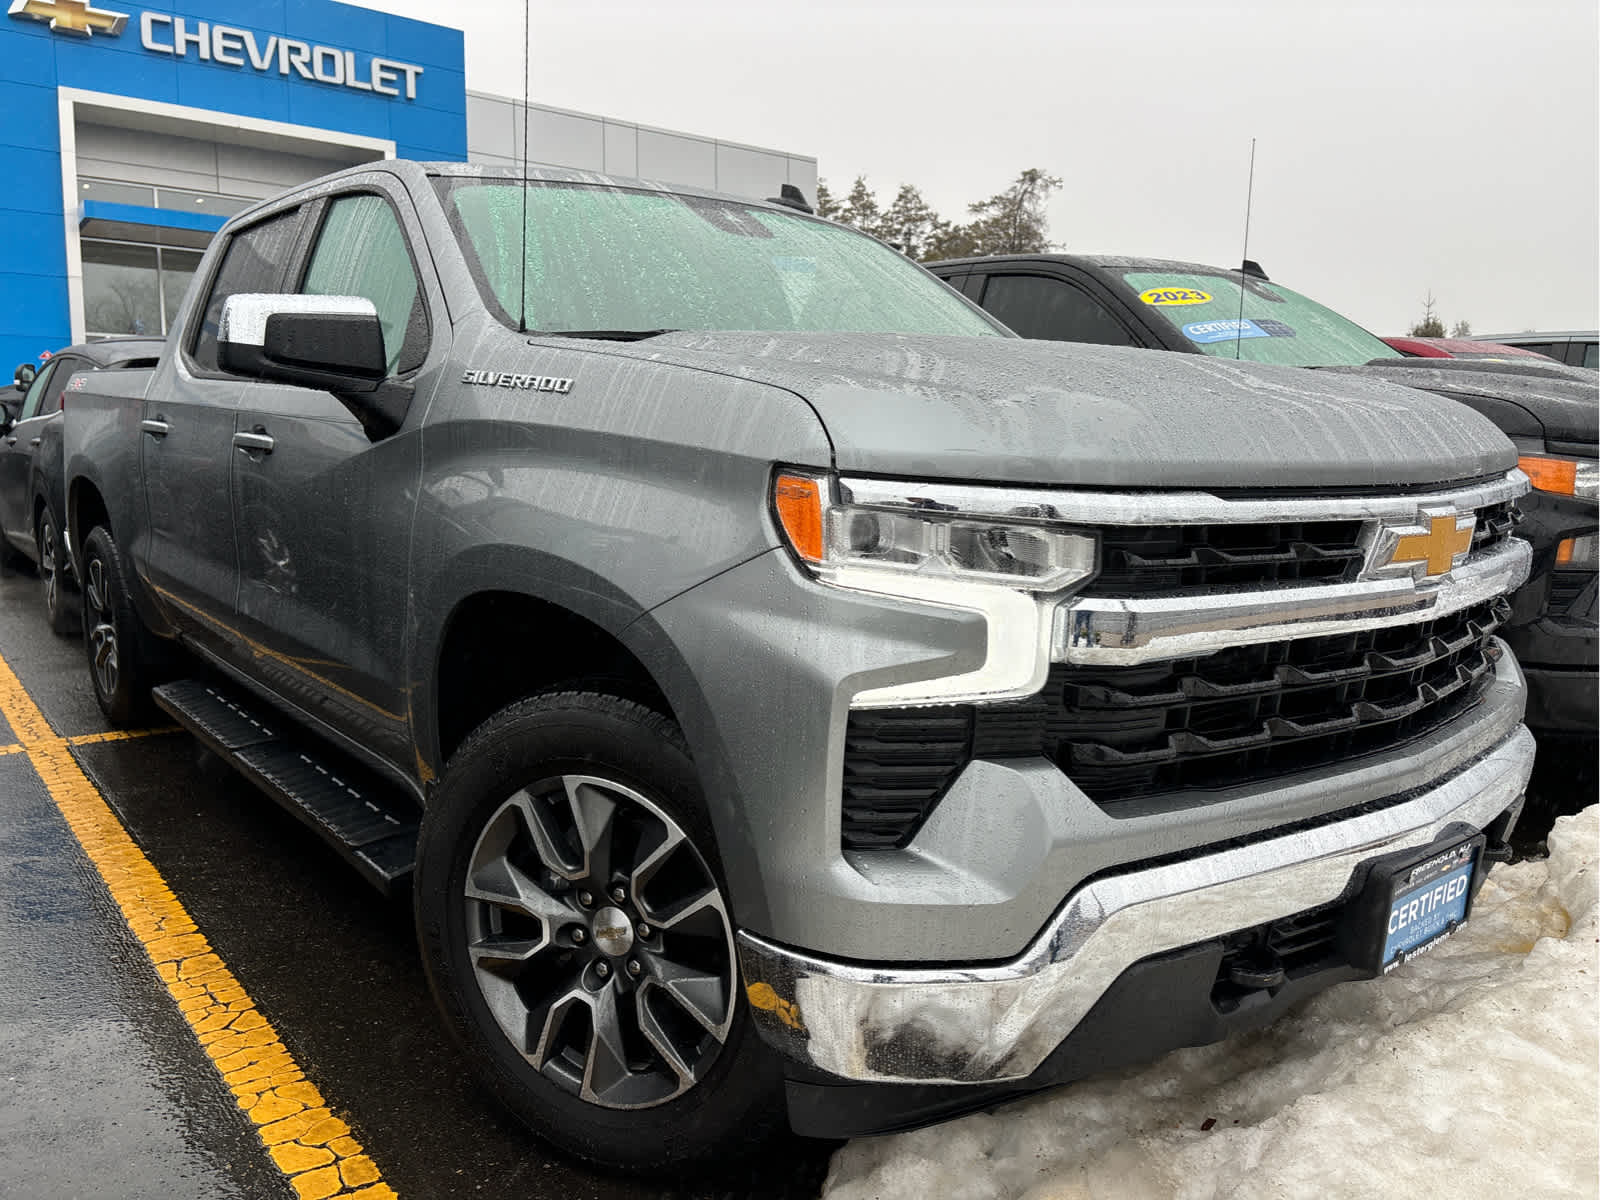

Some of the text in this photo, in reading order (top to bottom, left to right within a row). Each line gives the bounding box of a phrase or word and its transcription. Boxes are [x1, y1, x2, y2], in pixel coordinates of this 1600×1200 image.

[140, 10, 424, 99] CHEVROLET
[1148, 290, 1206, 303] 2023
[1188, 321, 1252, 335] CERTIFIED
[462, 369, 574, 392] SILVERADO
[1388, 874, 1468, 935] CERTIFIED
